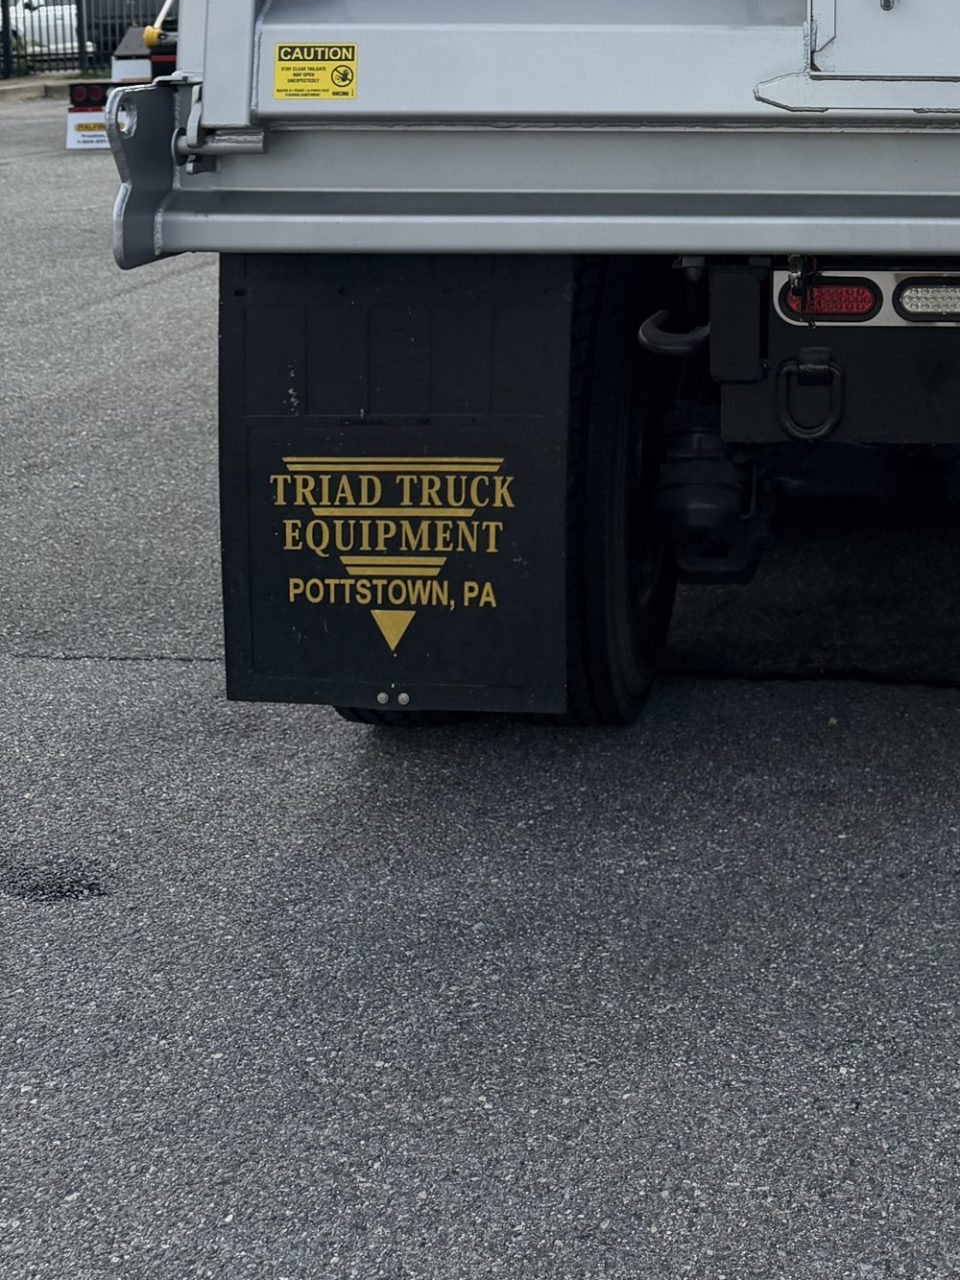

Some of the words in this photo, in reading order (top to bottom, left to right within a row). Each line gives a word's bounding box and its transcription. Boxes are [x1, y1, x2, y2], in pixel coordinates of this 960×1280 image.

[280, 47, 353, 60] CAUTION
[269, 475, 382, 507] TRIAD
[395, 475, 515, 508] TRUCK
[283, 519, 503, 558] EQUIPMENT
[288, 578, 456, 611] POTTSTOWN,
[463, 581, 497, 608] PA
